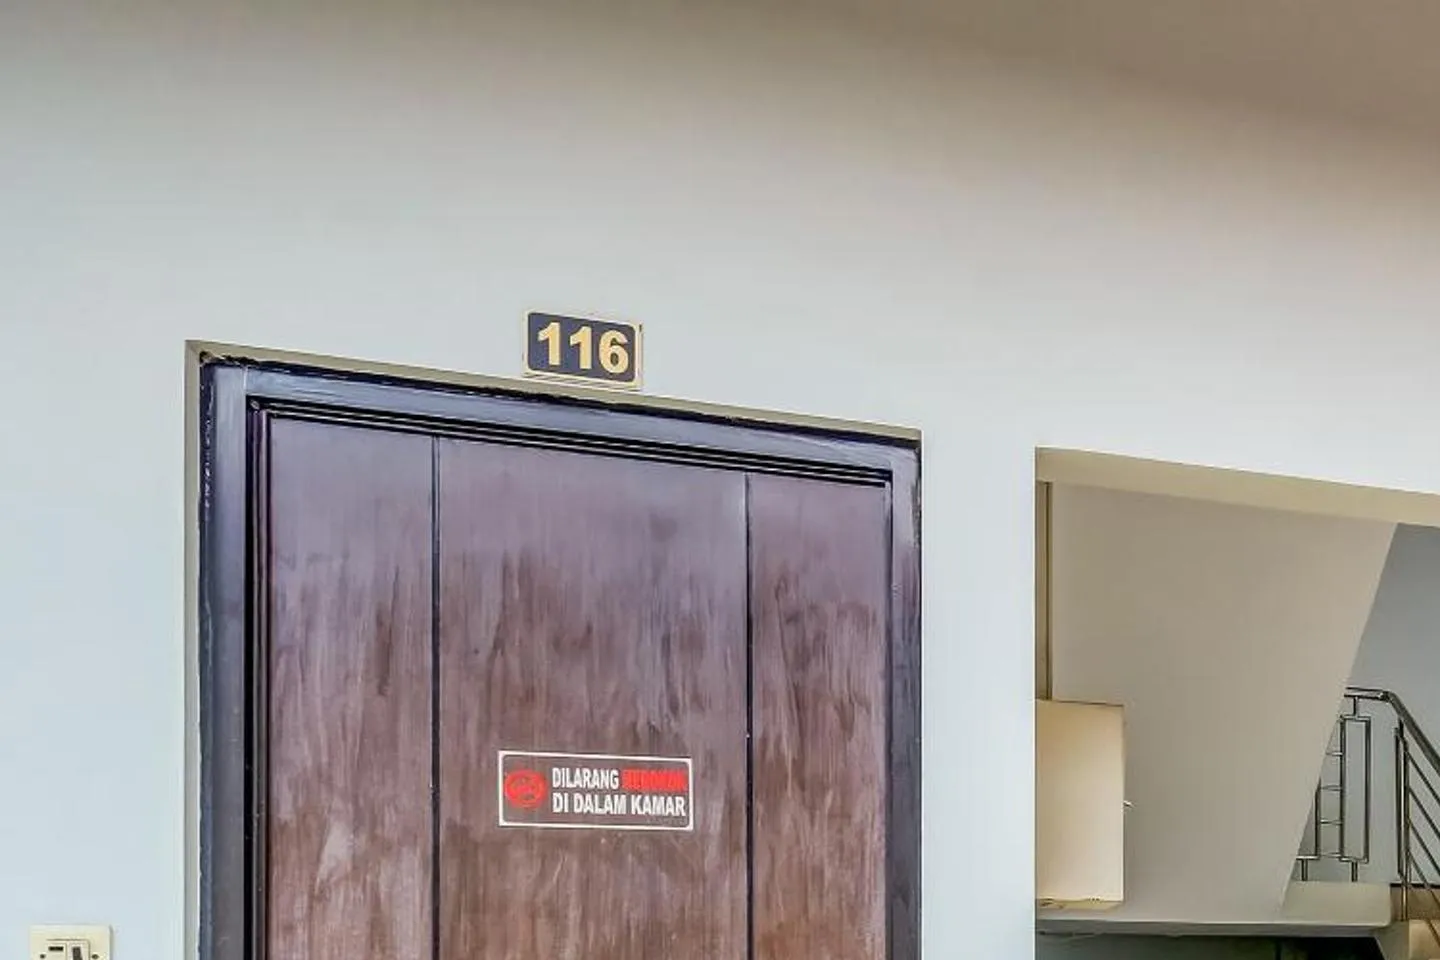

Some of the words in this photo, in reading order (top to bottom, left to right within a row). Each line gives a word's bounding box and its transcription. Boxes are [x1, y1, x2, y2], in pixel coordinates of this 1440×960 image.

[538, 322, 629, 374] 116
[552, 767, 619, 789] DILARANG
[552, 793, 569, 813] DI
[573, 794, 627, 815] DALAM
[631, 797, 687, 817] KAMAR
